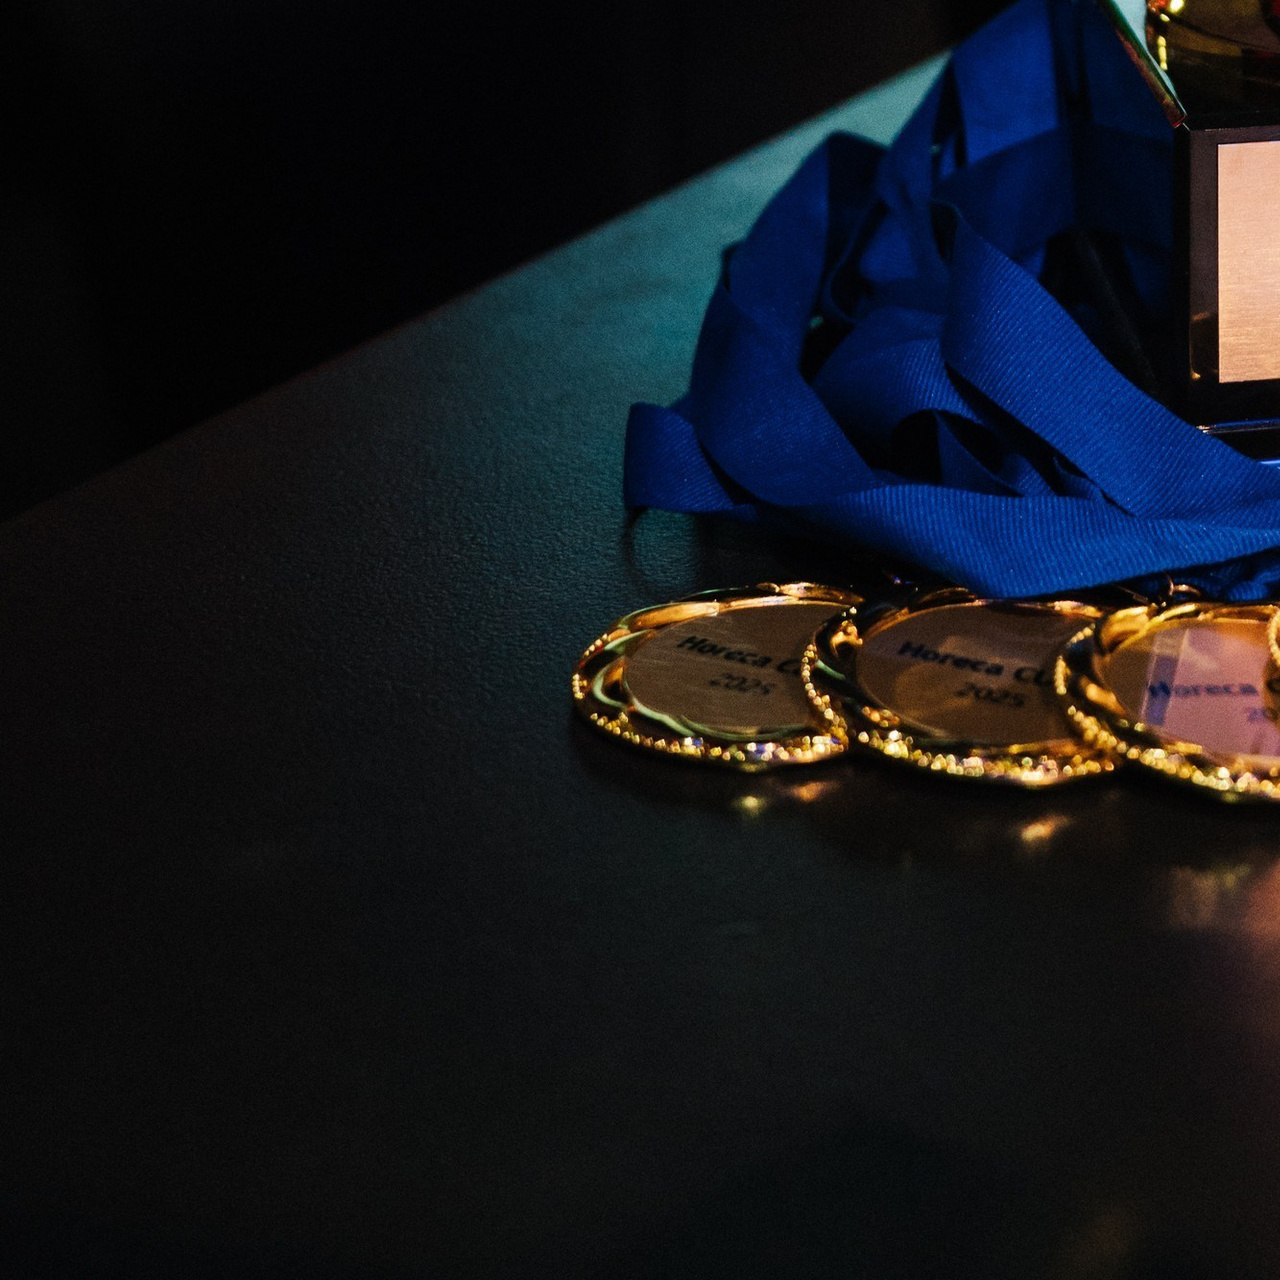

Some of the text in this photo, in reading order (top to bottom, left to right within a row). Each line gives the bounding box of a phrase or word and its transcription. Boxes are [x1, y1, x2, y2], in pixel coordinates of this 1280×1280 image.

[676, 635, 773, 668] Horeca
[897, 640, 1054, 687] Horeca CU
[1148, 680, 1259, 698] Horeca
